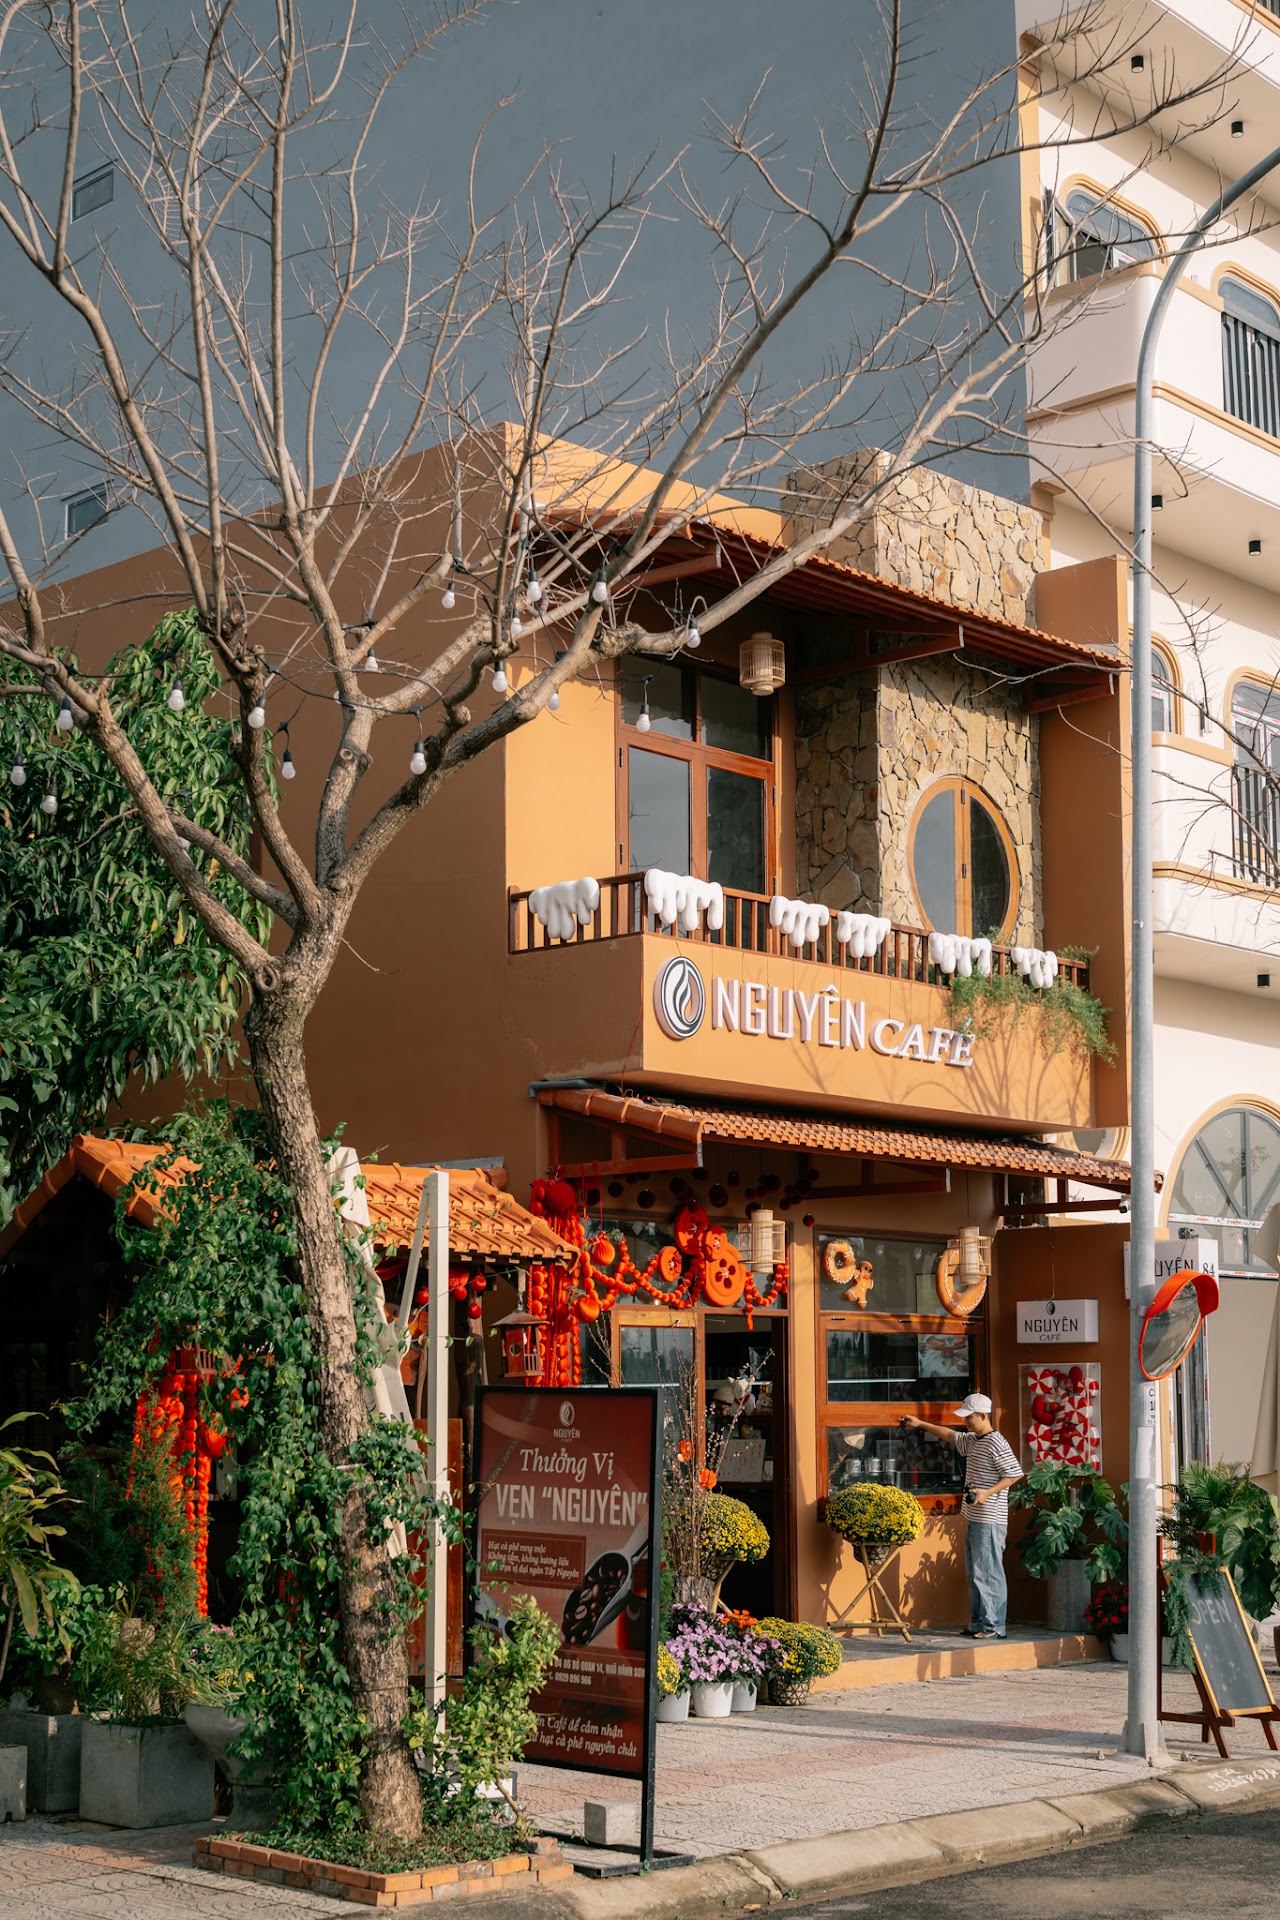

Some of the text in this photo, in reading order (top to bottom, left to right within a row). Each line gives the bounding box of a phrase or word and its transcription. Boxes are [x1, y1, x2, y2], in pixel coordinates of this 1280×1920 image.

[712, 976, 865, 1050] NGUYÊN
[1024, 1316, 1078, 1332] NGUYÊN
[1039, 1332, 1061, 1341] CAFÉ
[553, 1427, 581, 1438] NGUYÊN
[520, 1447, 614, 1483] Thưởng Vị
[496, 1483, 535, 1526] VẸN
[508, 1542, 519, 1553] phê
[521, 1554, 539, 1565] không
[556, 1567, 580, 1579] Nguyên
[1190, 1598, 1232, 1625] OPEN
[580, 1660, 596, 1673] QUAN
[547, 1715, 568, 1733] Café
[568, 1717, 581, 1732] để
[600, 1723, 623, 1739] nhận
[540, 1731, 555, 1747] hạt
[555, 1733, 566, 1747] cà
[566, 1736, 584, 1751] phê
[584, 1740, 616, 1756] nguyên
[617, 1740, 638, 1757] chất
